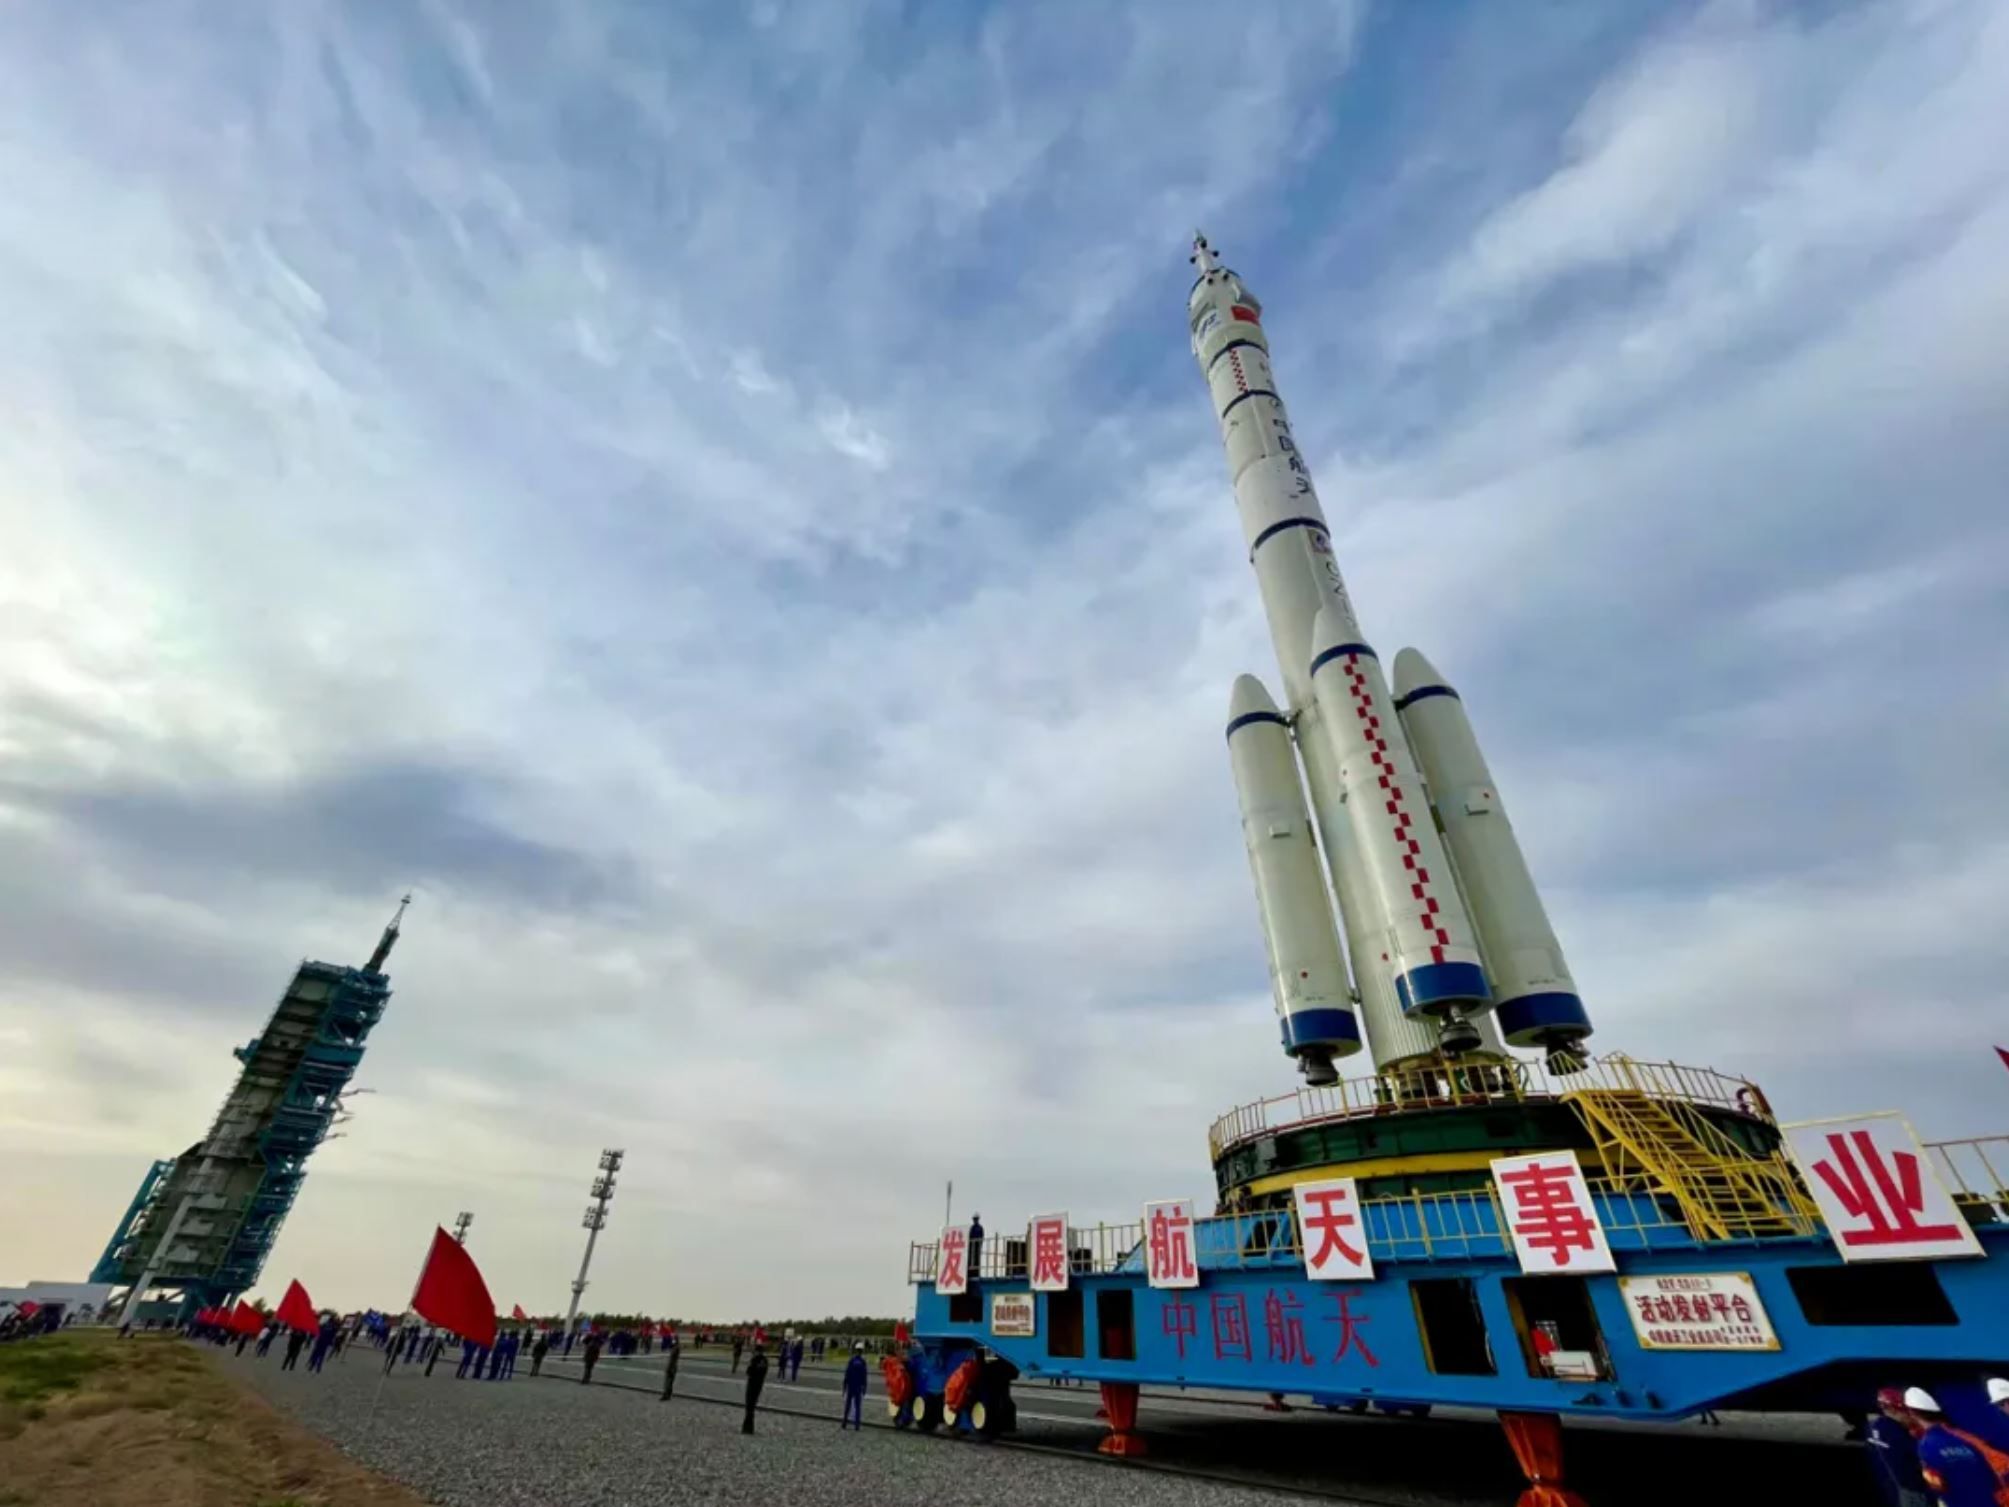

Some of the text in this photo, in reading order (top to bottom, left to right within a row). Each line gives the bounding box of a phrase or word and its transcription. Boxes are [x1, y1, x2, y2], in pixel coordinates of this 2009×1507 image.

[938, 1130, 1963, 1286] 发 展 航 天 事 业
[1161, 1288, 1380, 1367] 中国航天
[1634, 1293, 1753, 1323] 活动发射平台
